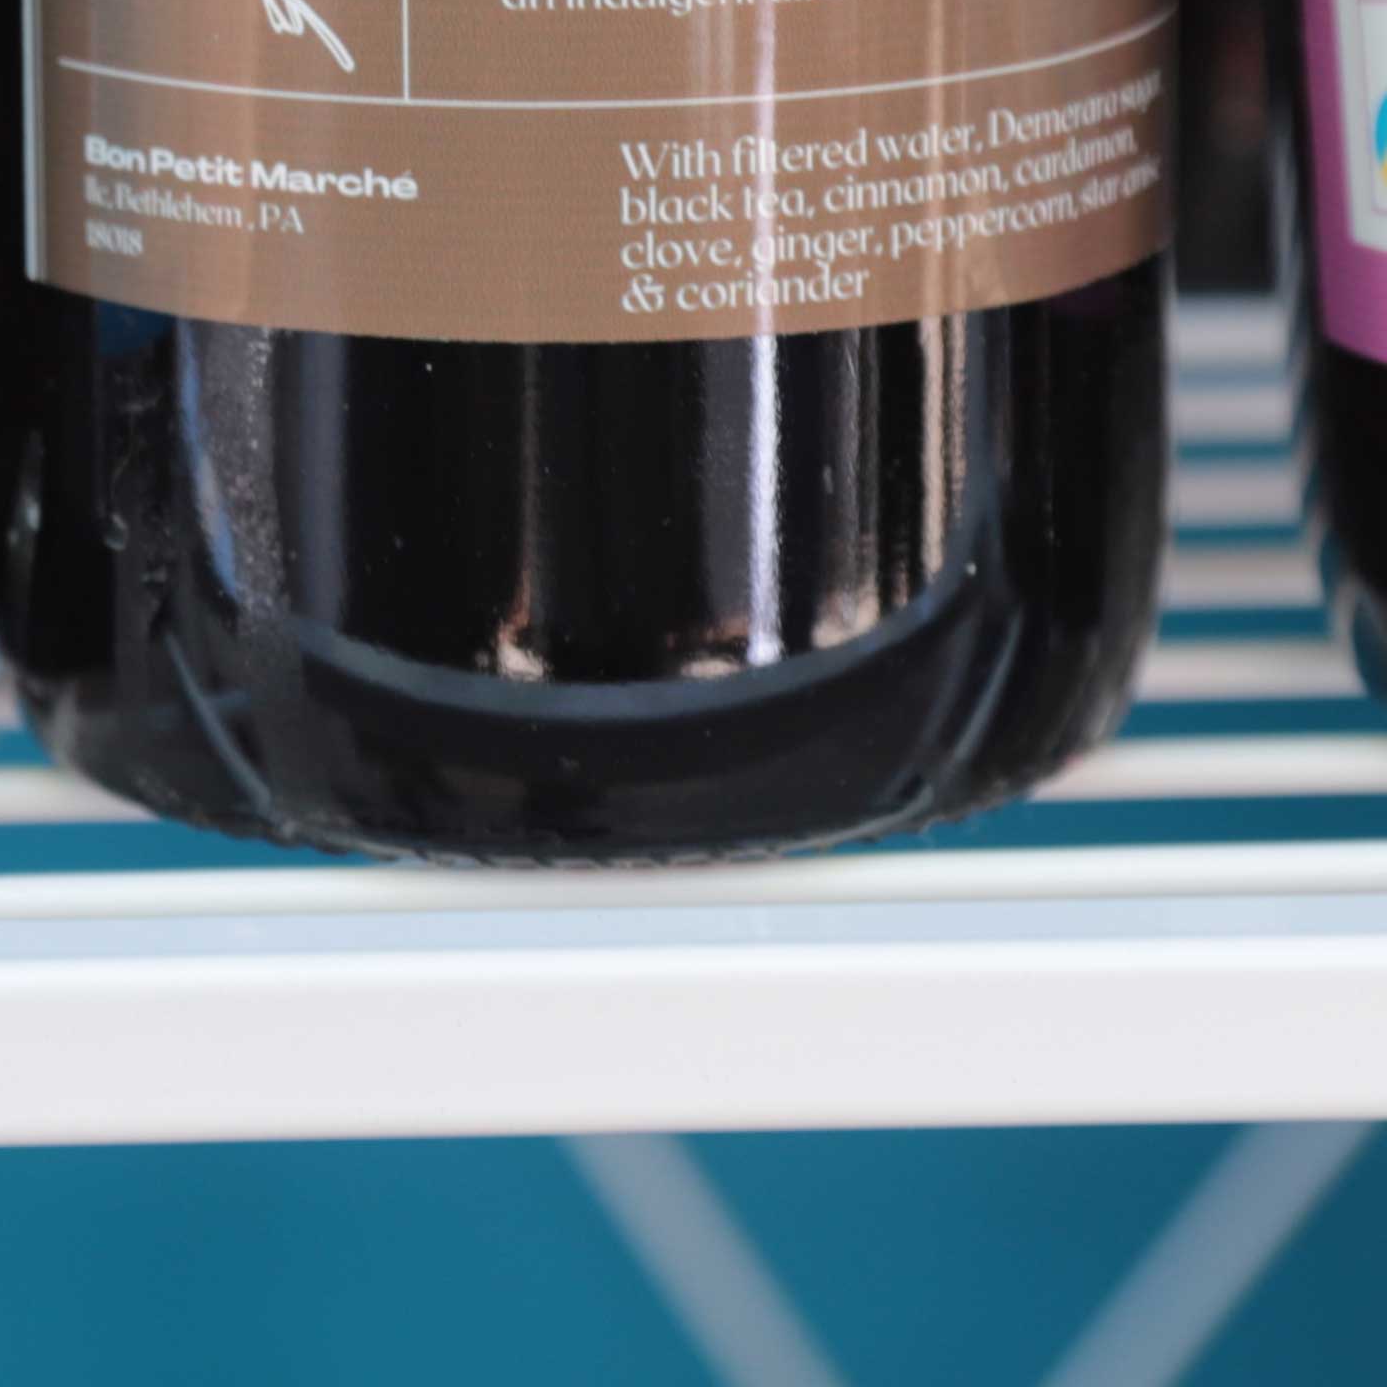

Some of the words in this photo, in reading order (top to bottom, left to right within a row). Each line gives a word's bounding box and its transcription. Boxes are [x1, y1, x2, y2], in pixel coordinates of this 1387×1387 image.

[620, 138, 722, 181] With
[731, 127, 869, 176] filtered
[876, 122, 983, 163] water,
[988, 89, 1118, 148] Demerara
[84, 133, 145, 174] Bon
[149, 146, 245, 187] Petit
[249, 159, 420, 202] Marché
[619, 183, 734, 226] black
[743, 186, 815, 219] tea,
[824, 163, 1010, 214] cinnamon,
[85, 218, 144, 256] 18018
[259, 202, 304, 236] PA
[620, 230, 743, 269] clove,
[751, 224, 883, 272] ginger,
[890, 191, 1077, 261] peppercorn,
[621, 272, 665, 313] &
[676, 263, 871, 312] coriander
